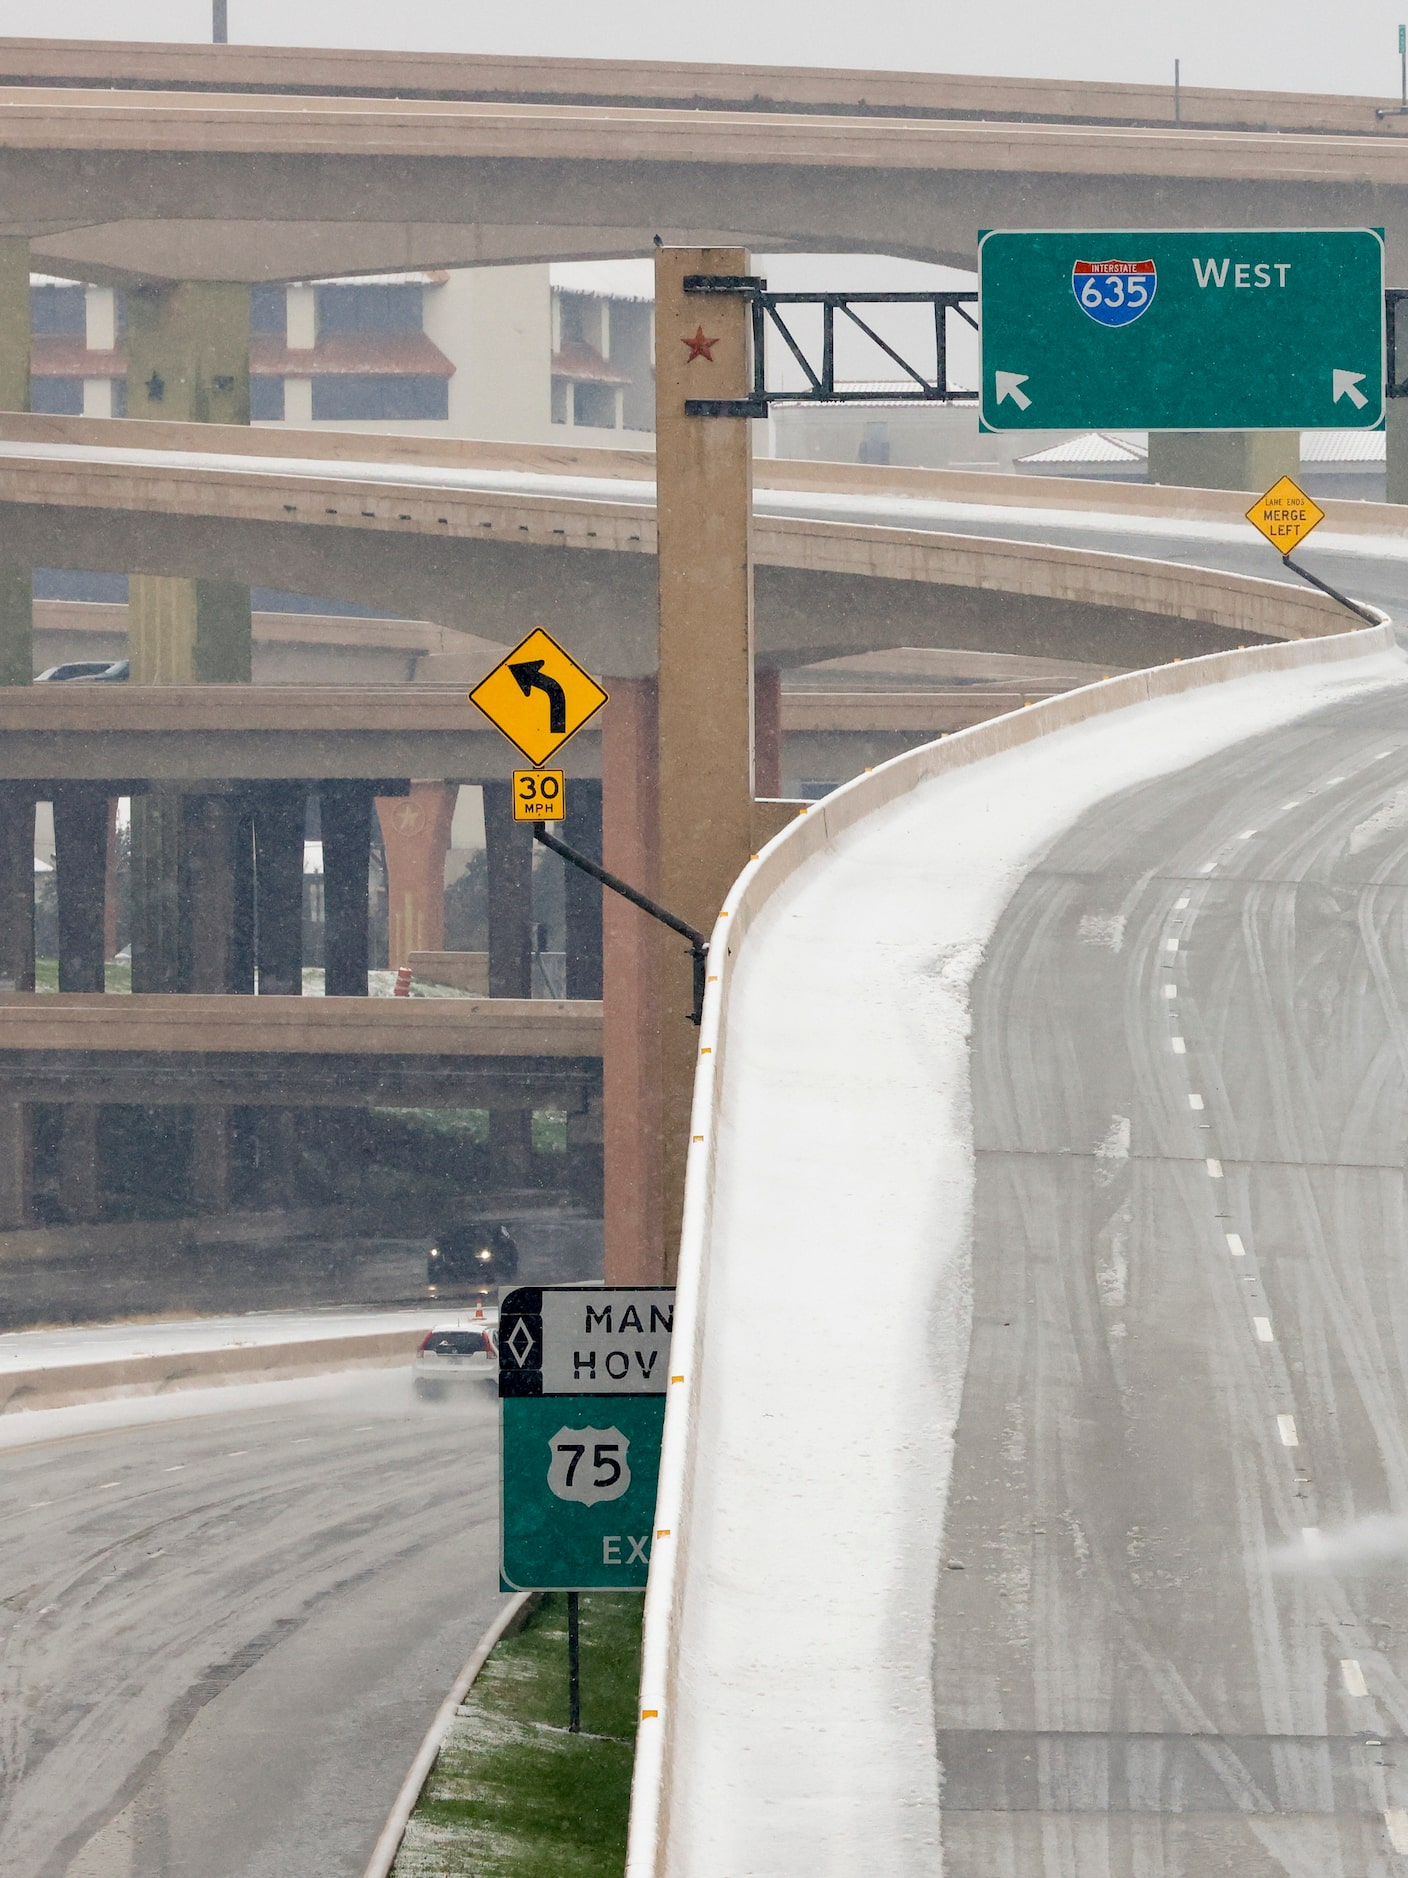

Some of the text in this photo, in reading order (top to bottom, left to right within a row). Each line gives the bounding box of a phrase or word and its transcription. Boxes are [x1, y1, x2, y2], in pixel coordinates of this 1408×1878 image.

[1091, 263, 1137, 273] INTERSTATE
[1192, 258, 1292, 288] WEST
[1081, 276, 1148, 308] 635
[1265, 498, 1305, 506] LANE ENDS
[1263, 510, 1307, 521] MERGE
[1270, 525, 1301, 536] LEFT
[519, 776, 559, 800] 30
[525, 803, 553, 813] MPH
[585, 1304, 674, 1333] MAN
[573, 1351, 658, 1379] HOV
[557, 1444, 622, 1488] 75
[603, 1535, 650, 1565] EX
